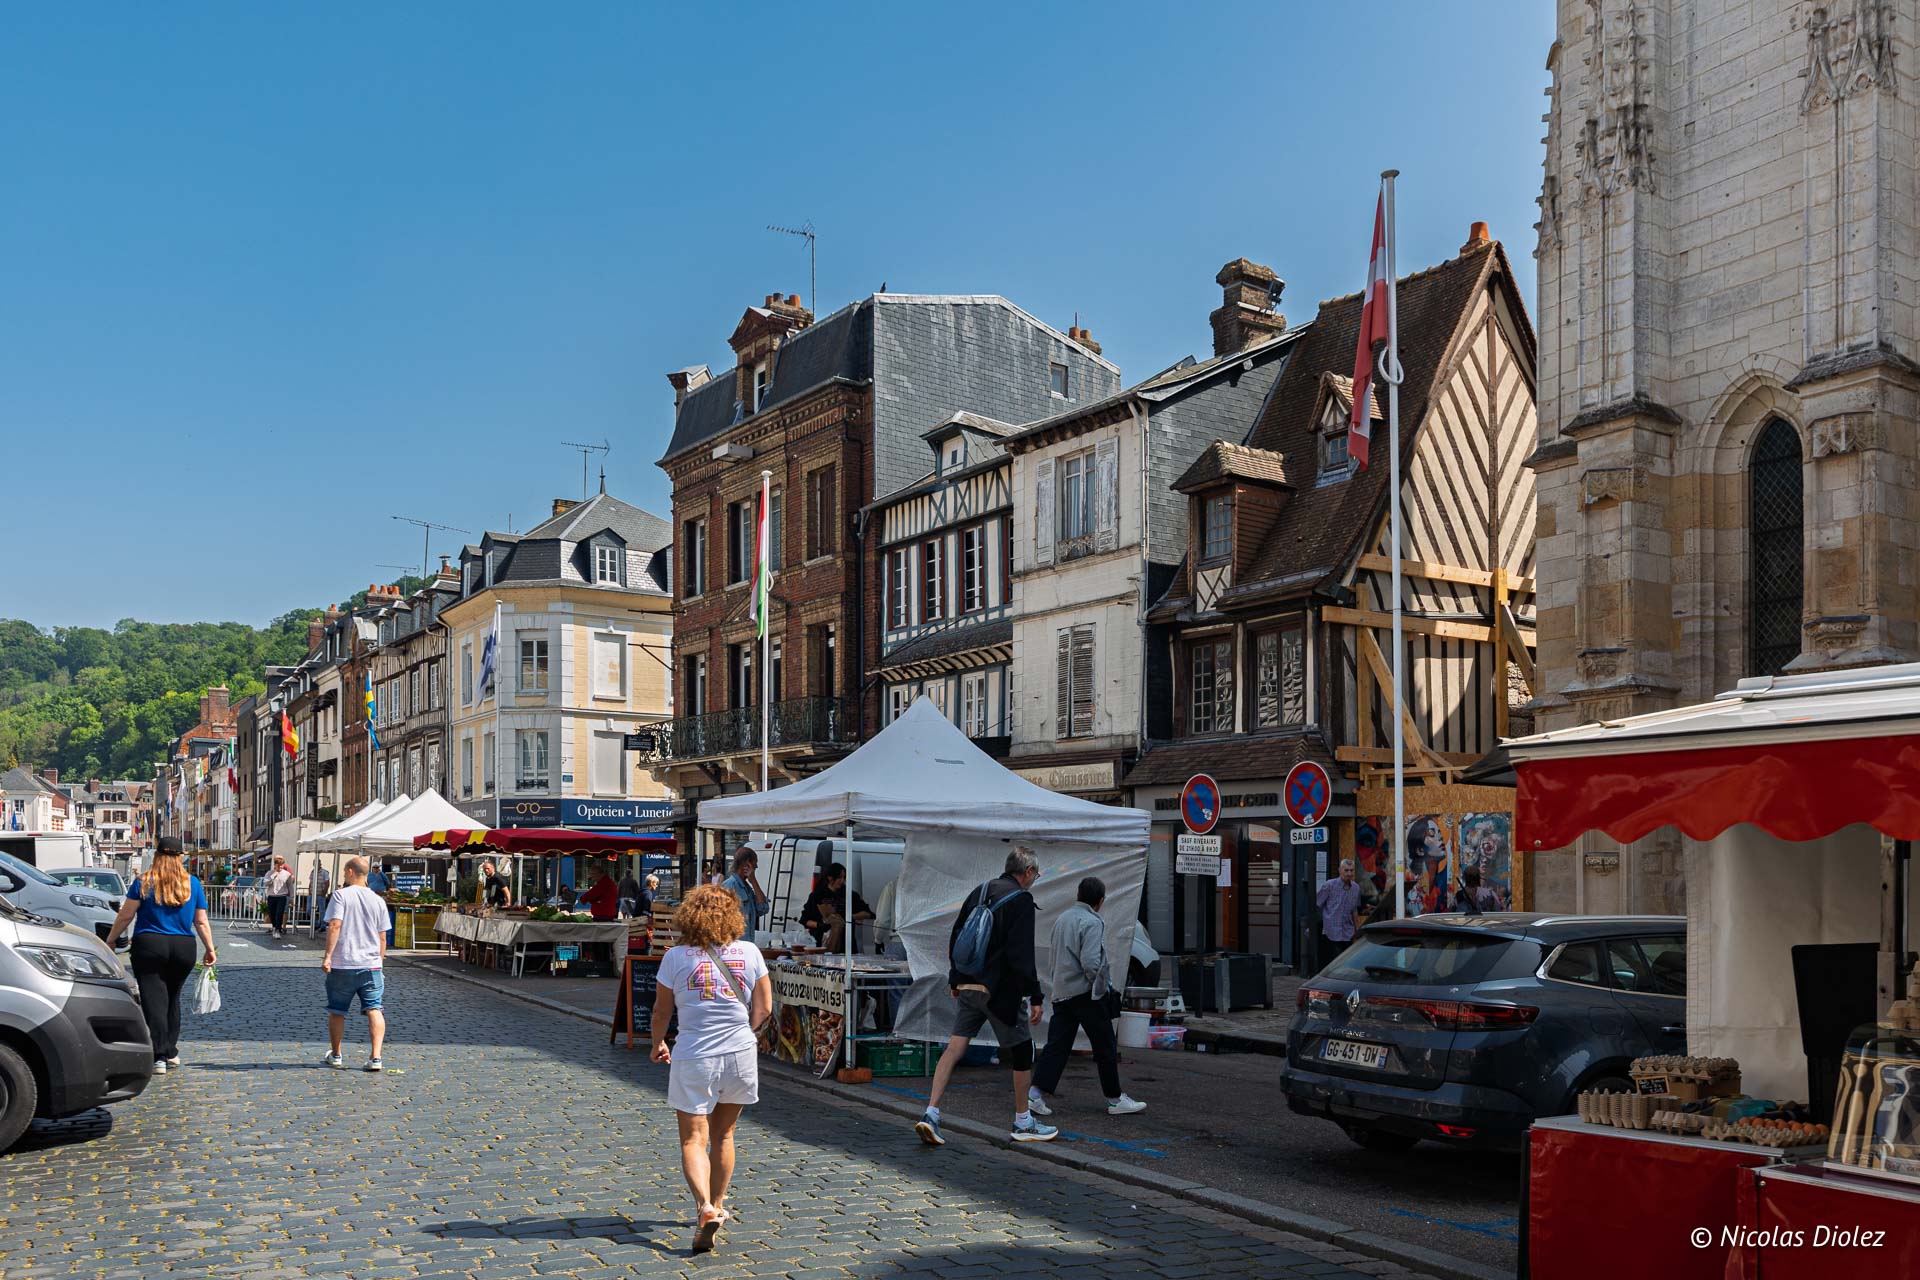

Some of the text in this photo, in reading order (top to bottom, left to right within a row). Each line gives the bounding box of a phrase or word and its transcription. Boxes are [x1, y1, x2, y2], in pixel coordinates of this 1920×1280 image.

[309, 747, 317, 793] PIZZERIA
[1048, 768, 1113, 788] Chaussures
[577, 803, 625, 820] Opticien
[1292, 831, 1313, 841] SAUF
[687, 959, 746, 1001] 45
[1327, 1041, 1378, 1064] GG-451-DW
